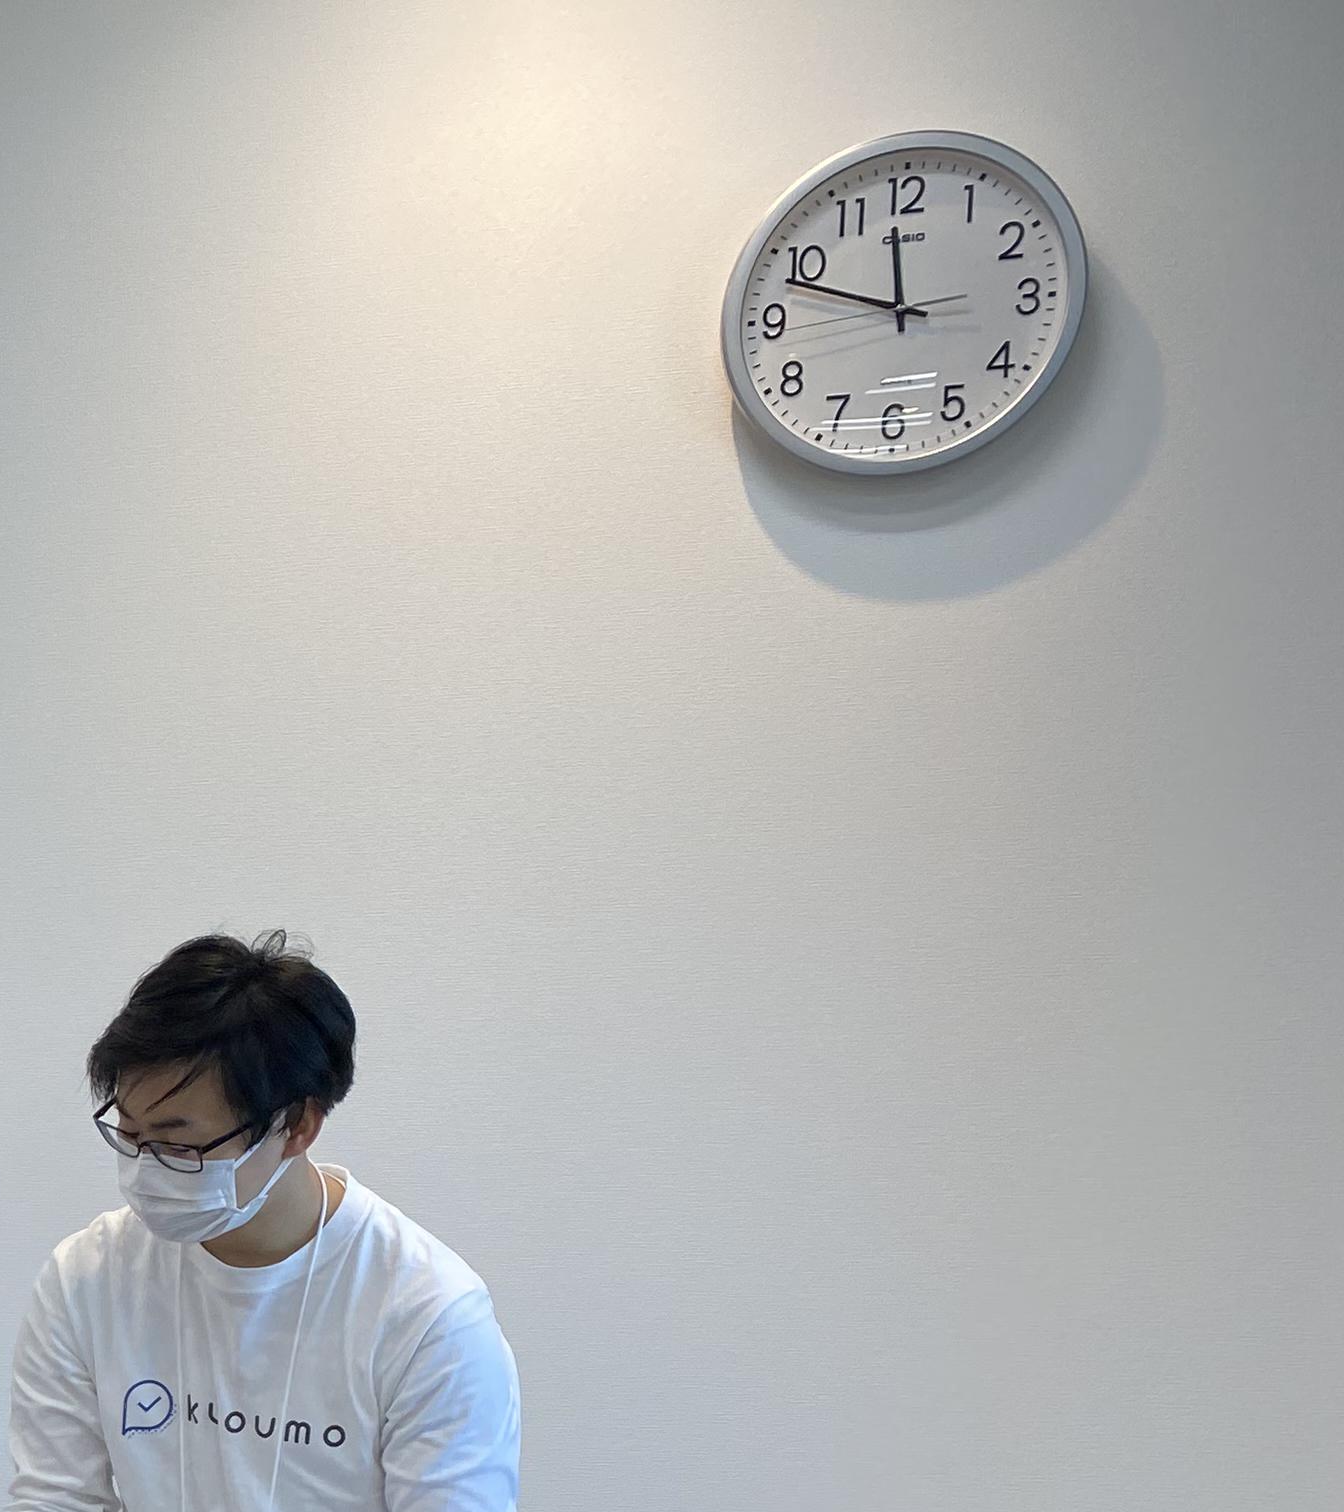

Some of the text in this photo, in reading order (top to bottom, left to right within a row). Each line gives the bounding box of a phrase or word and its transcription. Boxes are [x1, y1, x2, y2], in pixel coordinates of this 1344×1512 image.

[888, 175, 926, 216] 12
[964, 184, 975, 224] 1
[836, 197, 866, 237] 11
[882, 232, 926, 245] CSIO
[997, 220, 1026, 261] 2
[788, 244, 827, 282] 10
[1015, 277, 1041, 316] 3
[762, 302, 787, 339] 9
[985, 340, 1016, 378] 4
[779, 360, 804, 397] 8
[825, 393, 851, 433] 7
[880, 402, 906, 440] 6
[939, 383, 966, 421] 5
